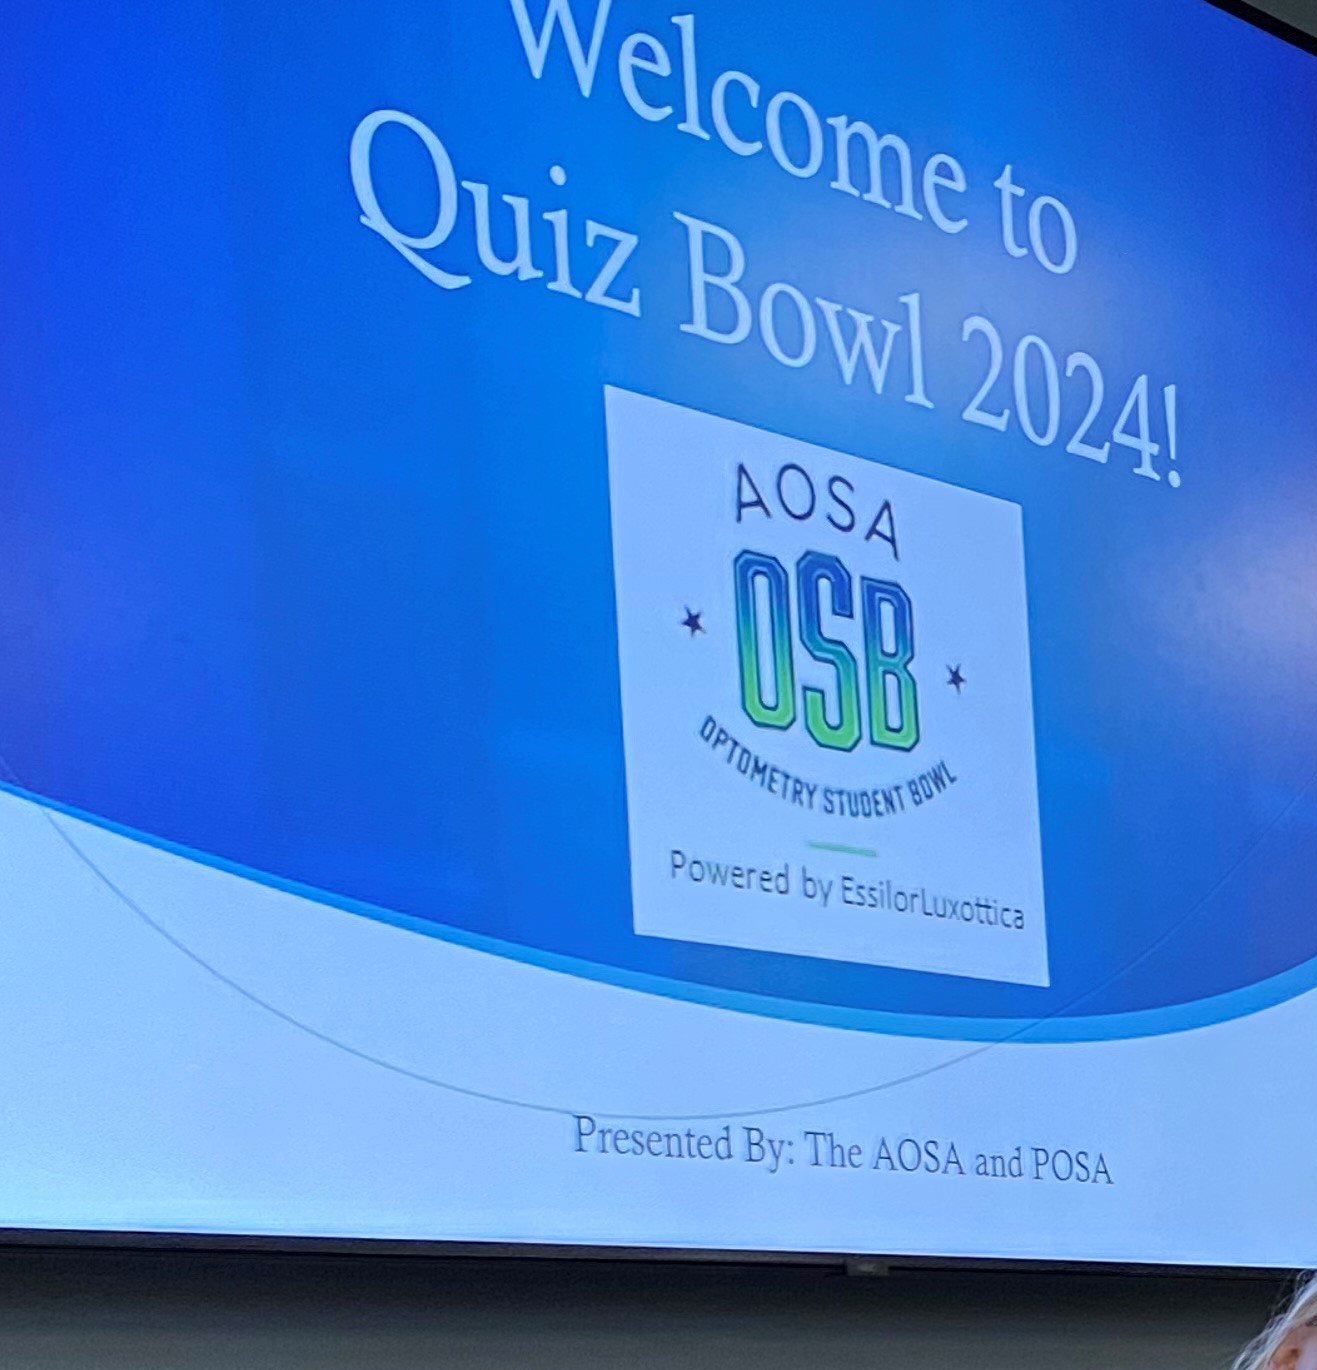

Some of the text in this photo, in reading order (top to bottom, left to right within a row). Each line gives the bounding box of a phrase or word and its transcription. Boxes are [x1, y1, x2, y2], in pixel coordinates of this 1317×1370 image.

[510, 0, 1078, 274] Welcome to
[349, 109, 1182, 488] Quiz Bowl 2024!
[735, 462, 901, 562] AOSA
[733, 549, 921, 753] OSB
[700, 715, 957, 818] OPTOMETRY STUDENT BOWL
[670, 850, 1026, 930] Powered by EssilorLuxottica
[571, 1114, 1115, 1185] Presented By: The AOSA and POSA
